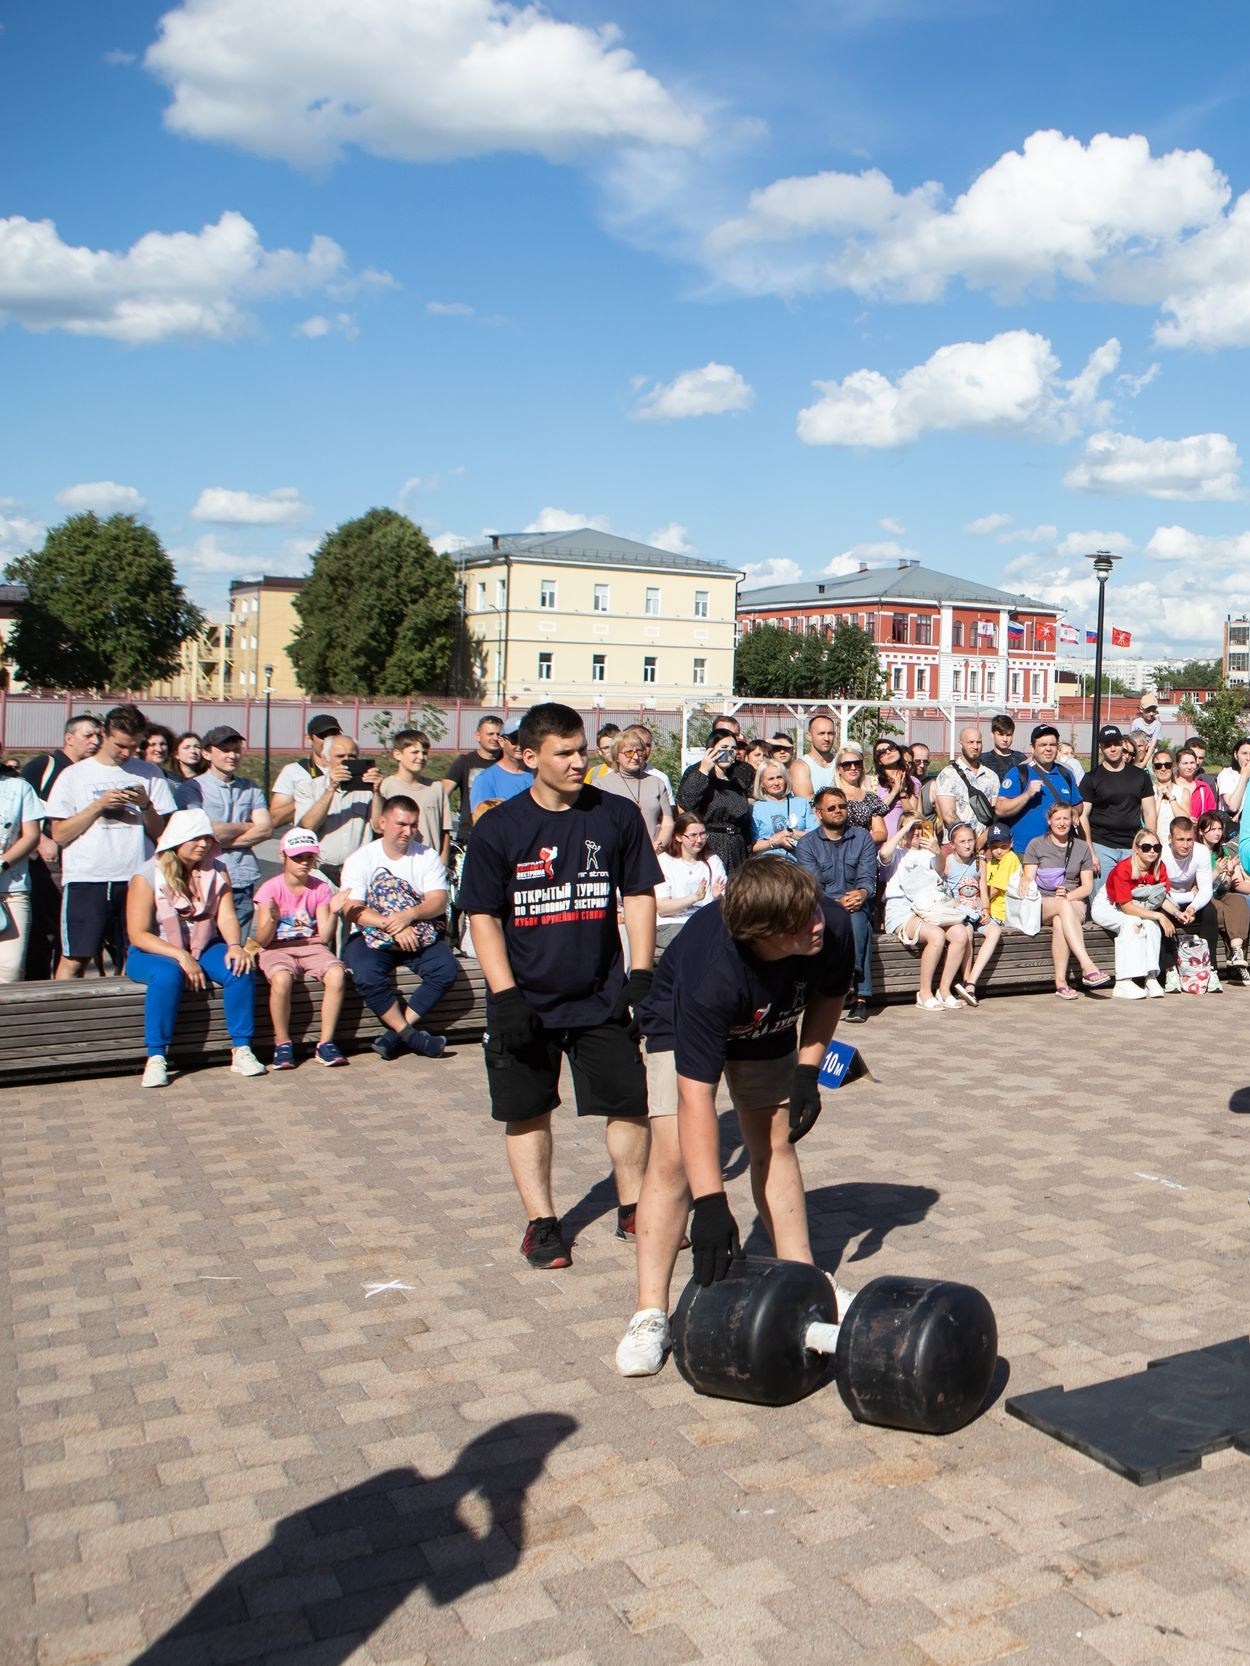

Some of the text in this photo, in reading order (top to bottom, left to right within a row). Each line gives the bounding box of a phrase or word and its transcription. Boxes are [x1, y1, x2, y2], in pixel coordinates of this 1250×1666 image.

[514, 883, 571, 904] ОТКРЫТЫЙ
[515, 907, 525, 916] ПО
[530, 900, 570, 914] СИЛОВОМУ
[515, 918, 537, 926] КУБОК
